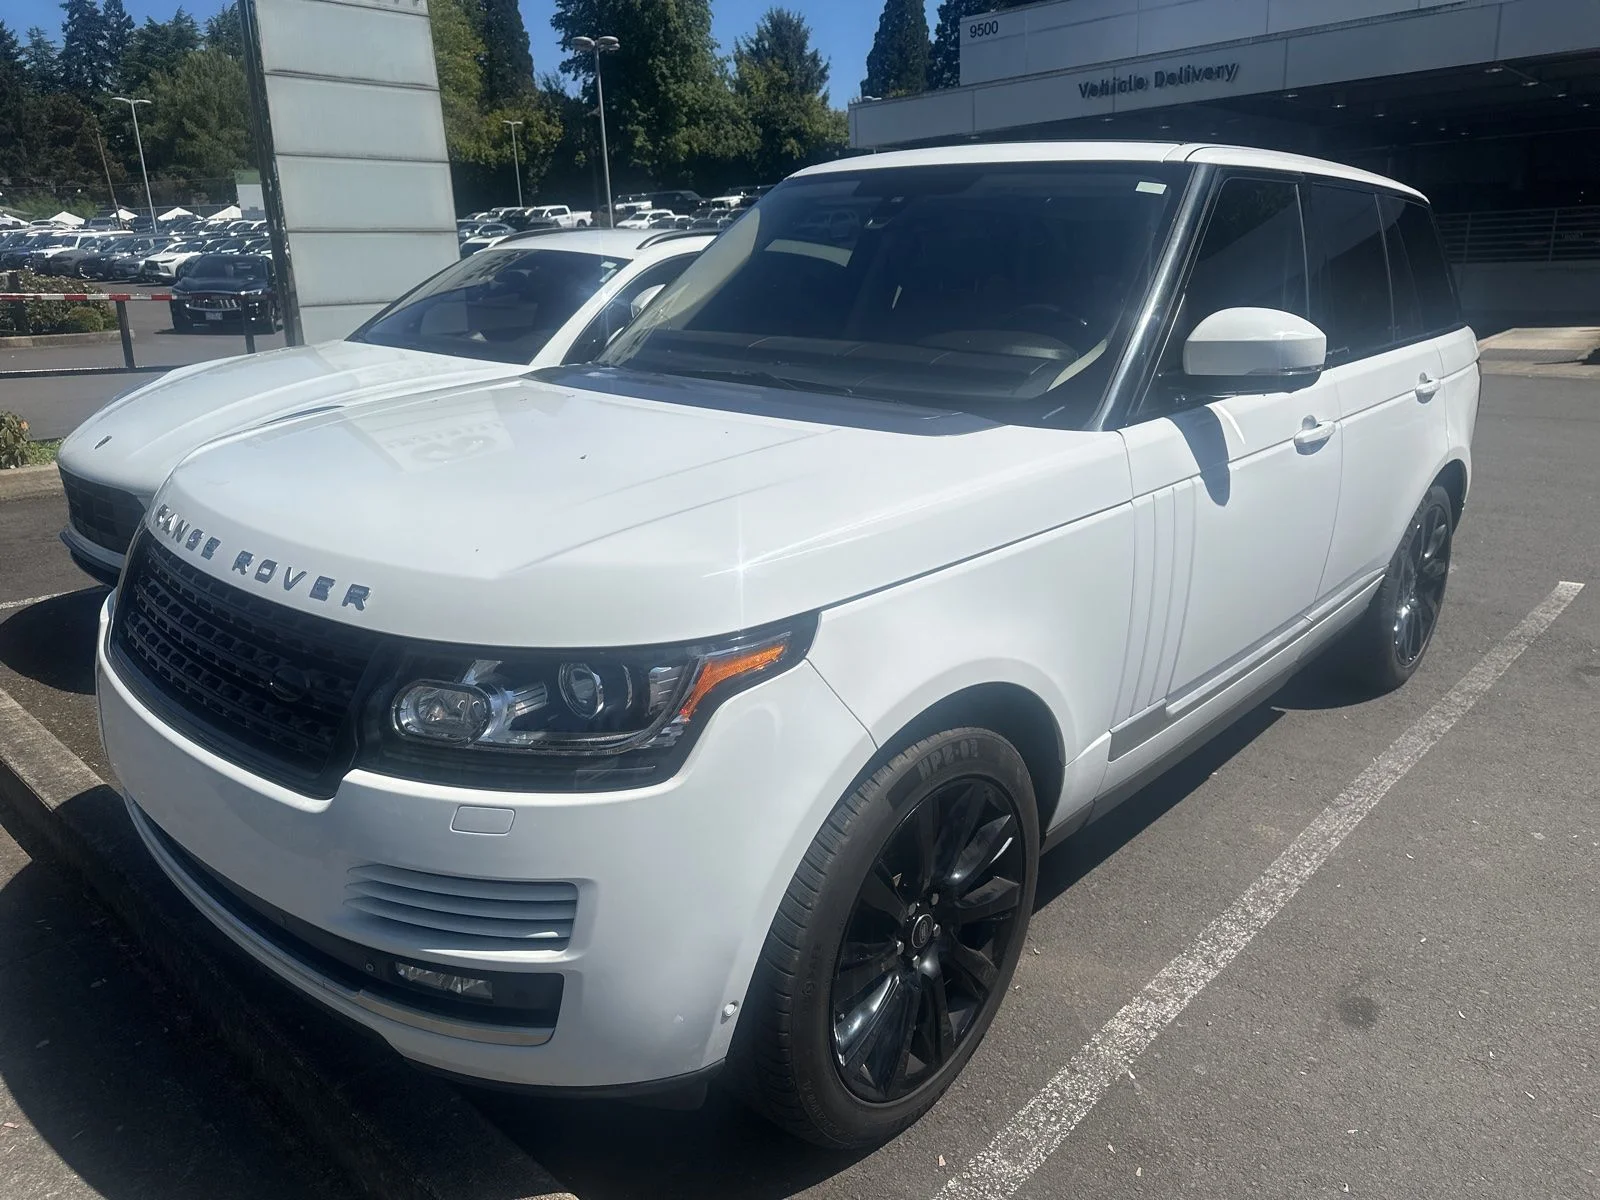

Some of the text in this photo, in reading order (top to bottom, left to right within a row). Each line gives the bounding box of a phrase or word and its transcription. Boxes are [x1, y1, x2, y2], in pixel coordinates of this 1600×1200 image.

[969, 20, 999, 39] 9500
[1078, 61, 1240, 99] Vehicle Delivery
[155, 503, 372, 612] RANGE ROVER
